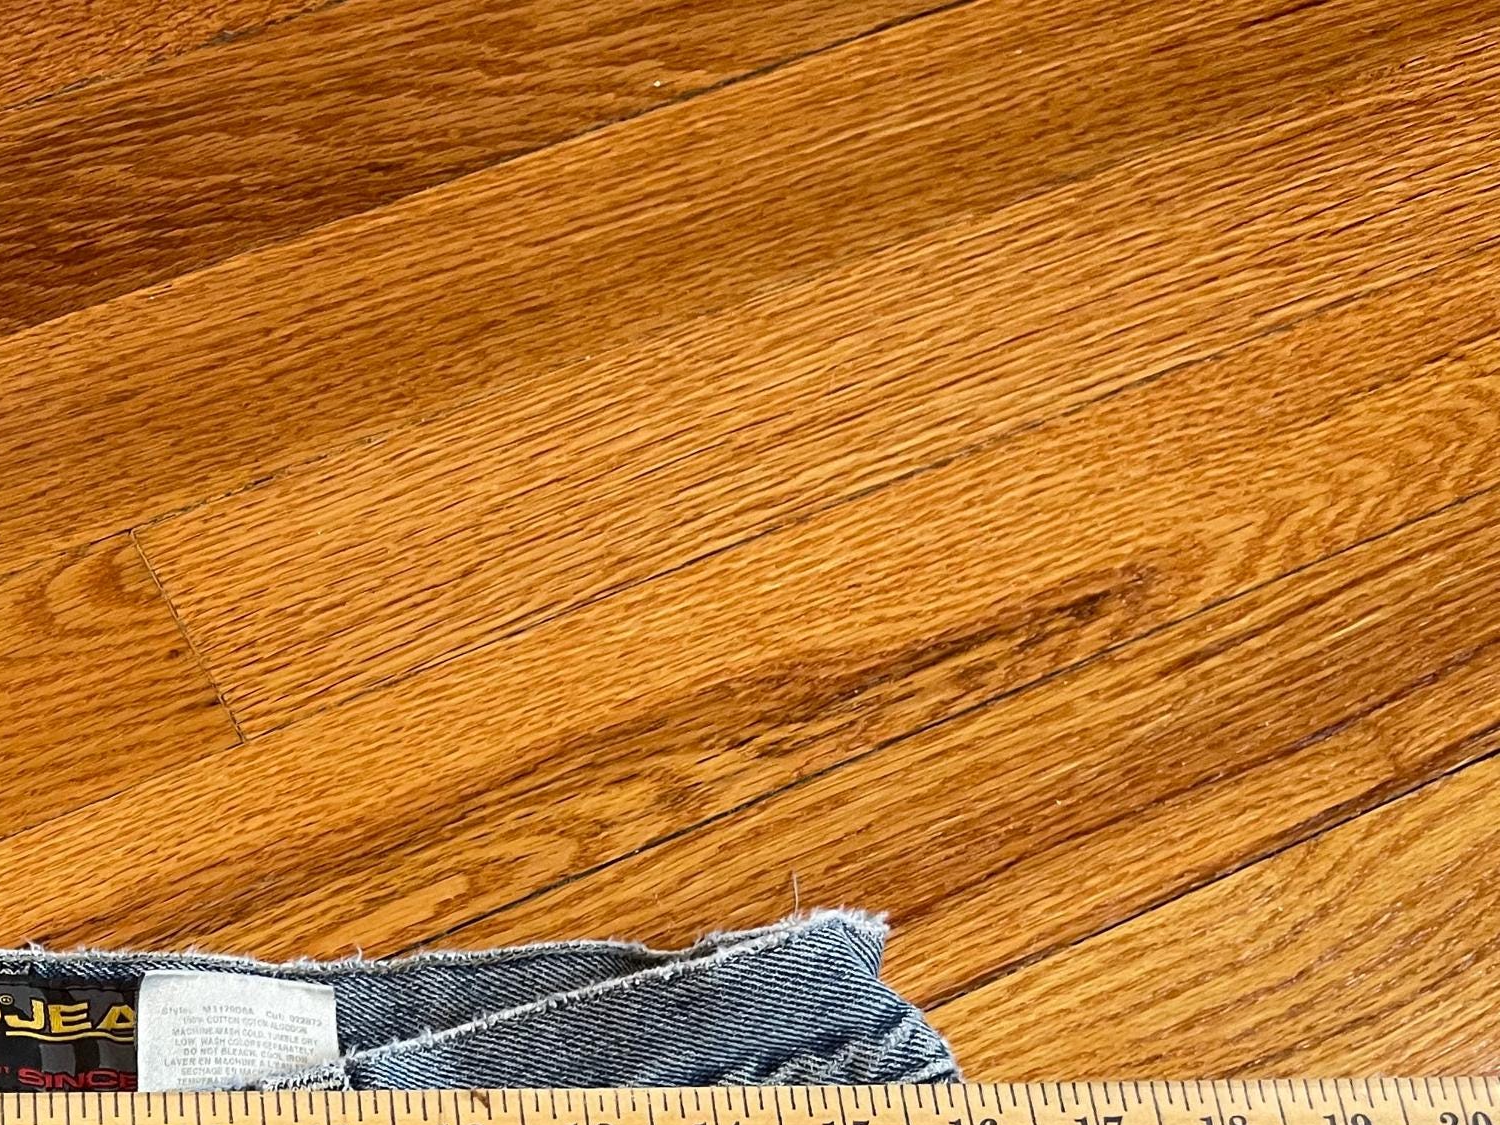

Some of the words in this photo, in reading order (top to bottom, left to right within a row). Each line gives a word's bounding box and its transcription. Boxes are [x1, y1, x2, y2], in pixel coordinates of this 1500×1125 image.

[207, 1016, 239, 1024] COTTON
[172, 1028, 213, 1036] MACHINE
[216, 1027, 240, 1035] WASH
[201, 1037, 225, 1045] WASH
[261, 1050, 283, 1060] COOL
[164, 1058, 196, 1066] LAVER
[199, 1057, 211, 1065] EN
[215, 1057, 255, 1066] MACHINE
